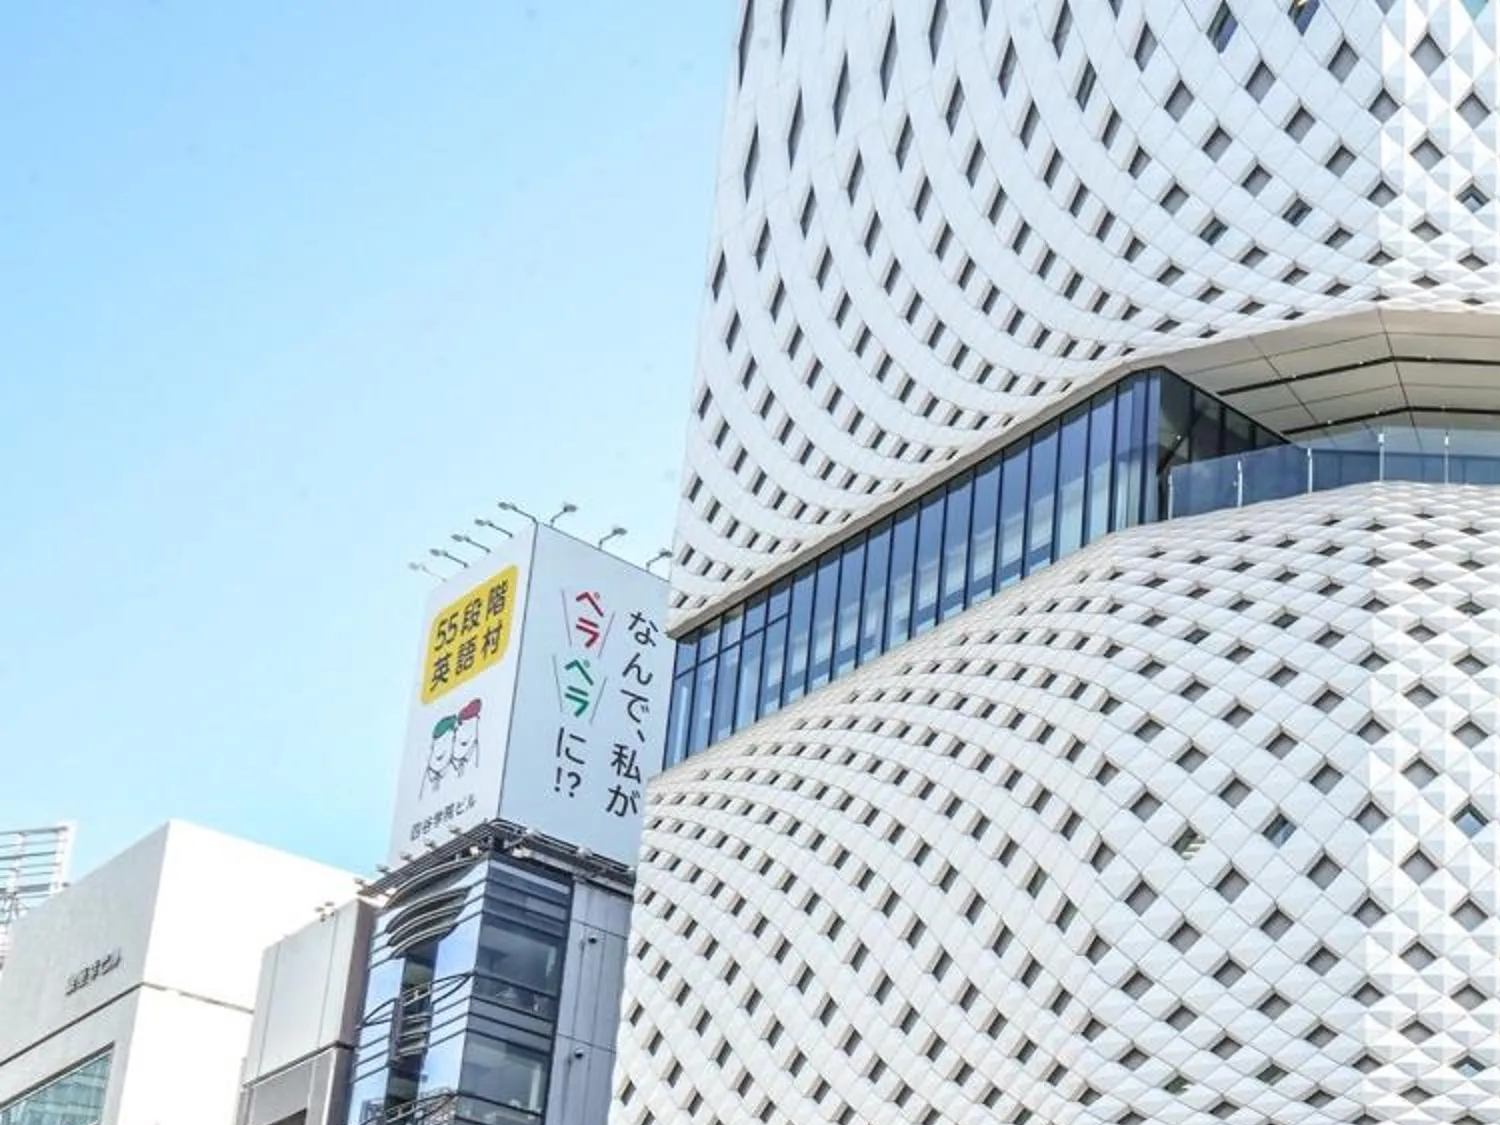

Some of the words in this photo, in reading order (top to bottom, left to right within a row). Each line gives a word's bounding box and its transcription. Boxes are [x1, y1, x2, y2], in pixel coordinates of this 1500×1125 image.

[434, 579, 510, 652] 55段階
[429, 620, 503, 693] 英語村
[604, 610, 659, 818] なんで、私が
